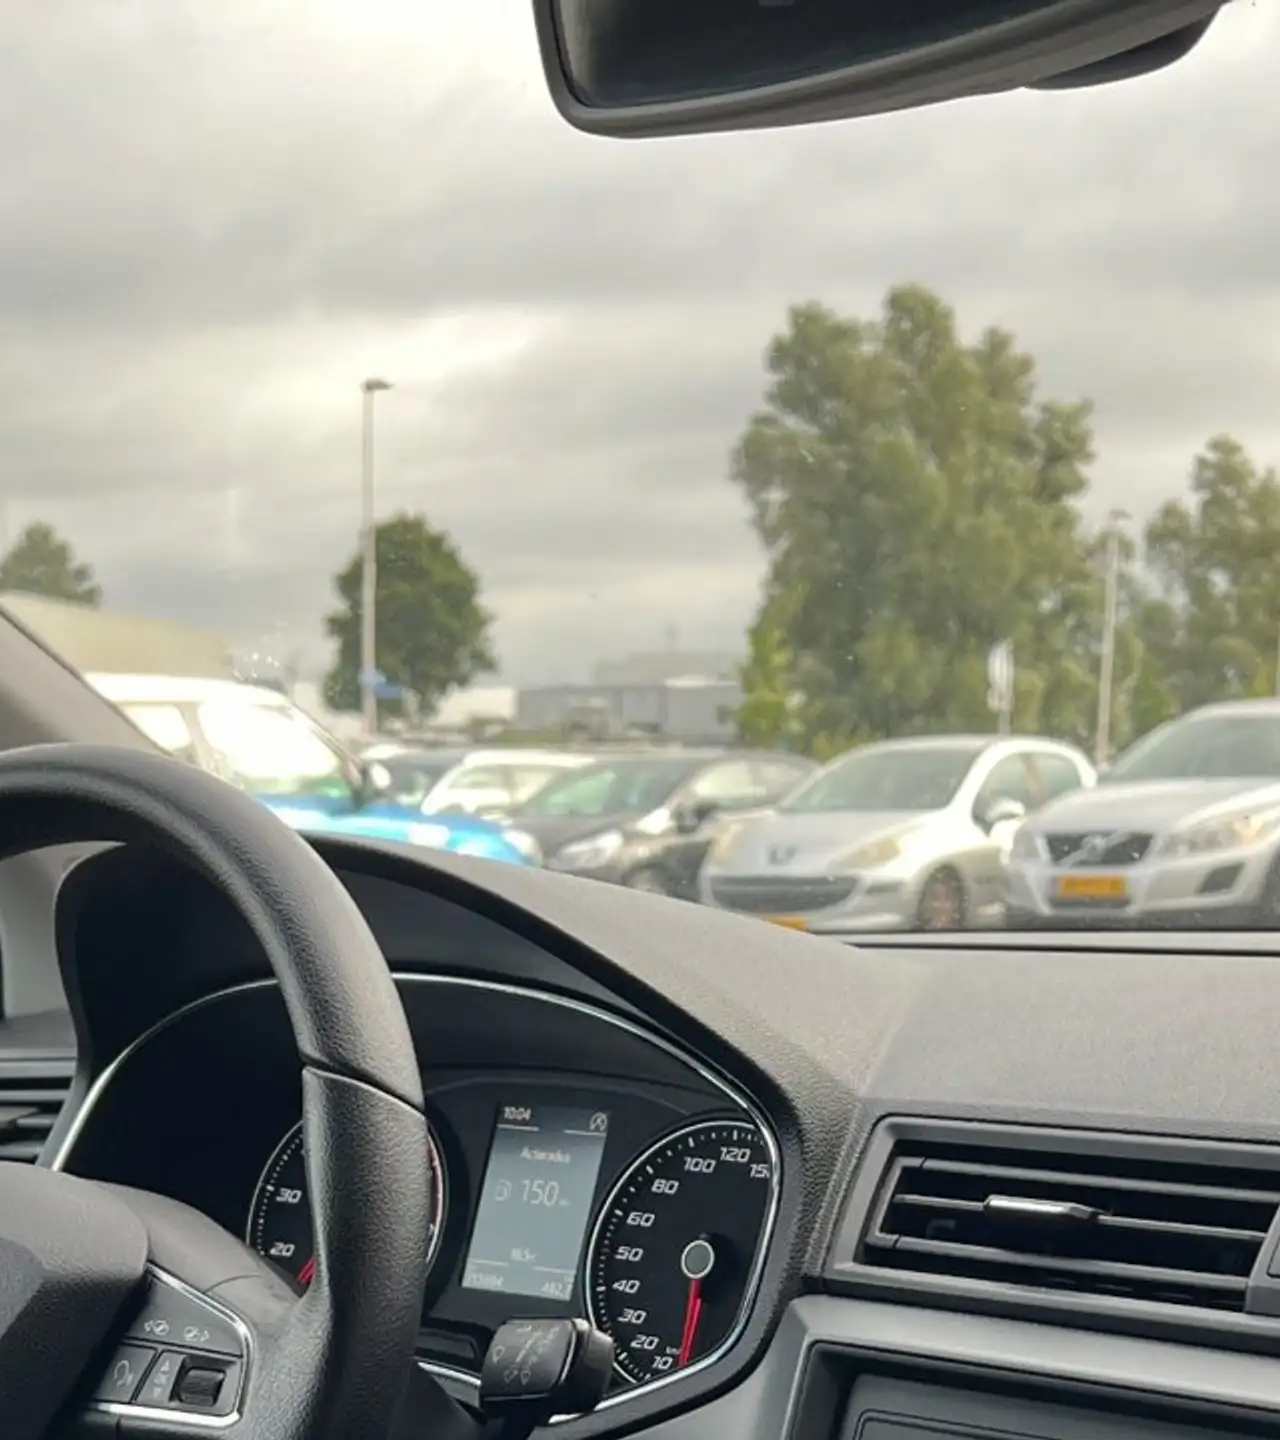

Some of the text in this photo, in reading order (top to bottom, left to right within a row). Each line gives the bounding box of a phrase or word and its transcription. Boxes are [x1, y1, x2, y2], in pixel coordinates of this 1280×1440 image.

[720, 1146, 751, 1163] 120
[682, 1156, 717, 1174] 100
[522, 1179, 560, 1207] 150
[650, 1178, 680, 1195] 80
[275, 1187, 303, 1204] 30
[625, 1211, 656, 1228] 60
[269, 1241, 296, 1257] 20
[614, 1246, 644, 1262] 50
[612, 1279, 641, 1294] 40
[617, 1307, 647, 1325] 30
[630, 1334, 660, 1350] 20
[651, 1355, 673, 1369] 10
